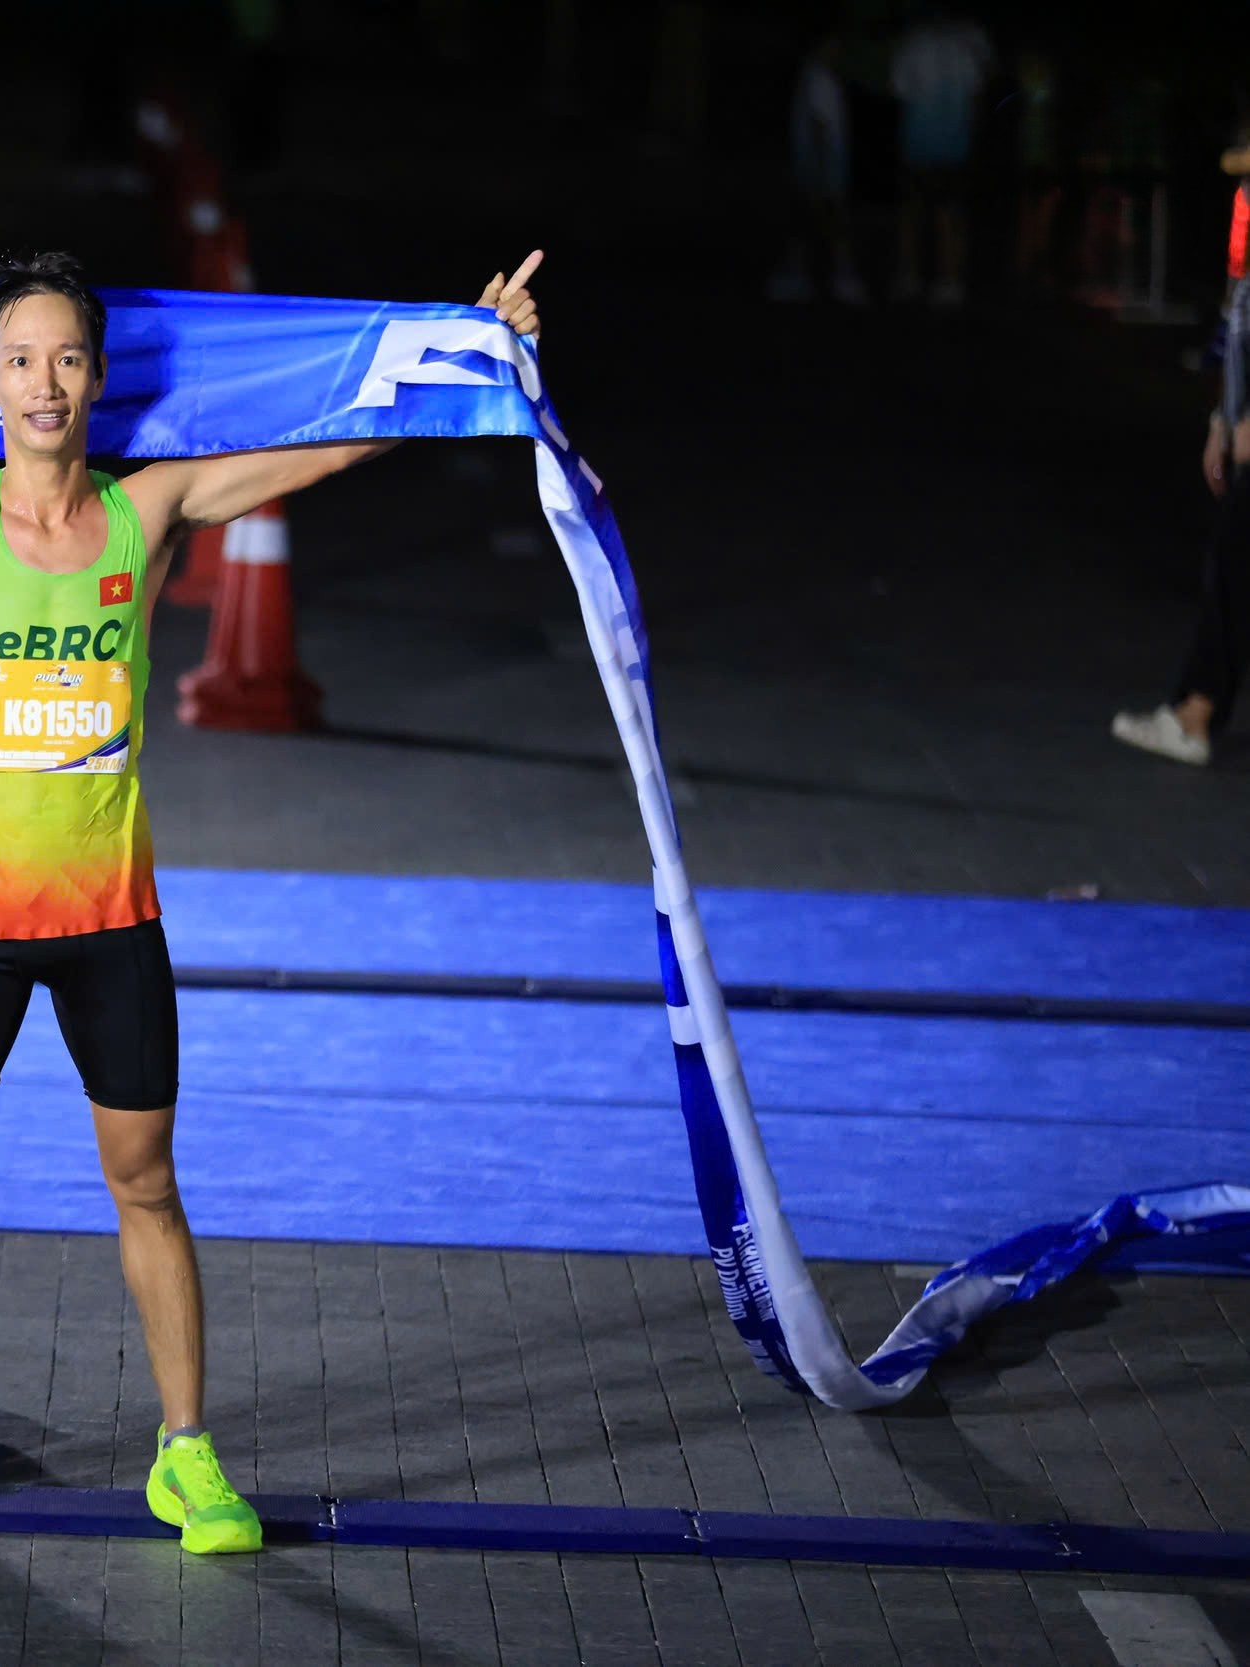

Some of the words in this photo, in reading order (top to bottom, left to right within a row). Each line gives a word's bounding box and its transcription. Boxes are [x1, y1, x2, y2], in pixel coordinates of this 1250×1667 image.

[60, 673, 84, 684] RUN
[4, 700, 112, 737] K81550
[86, 757, 122, 770] 25KM
